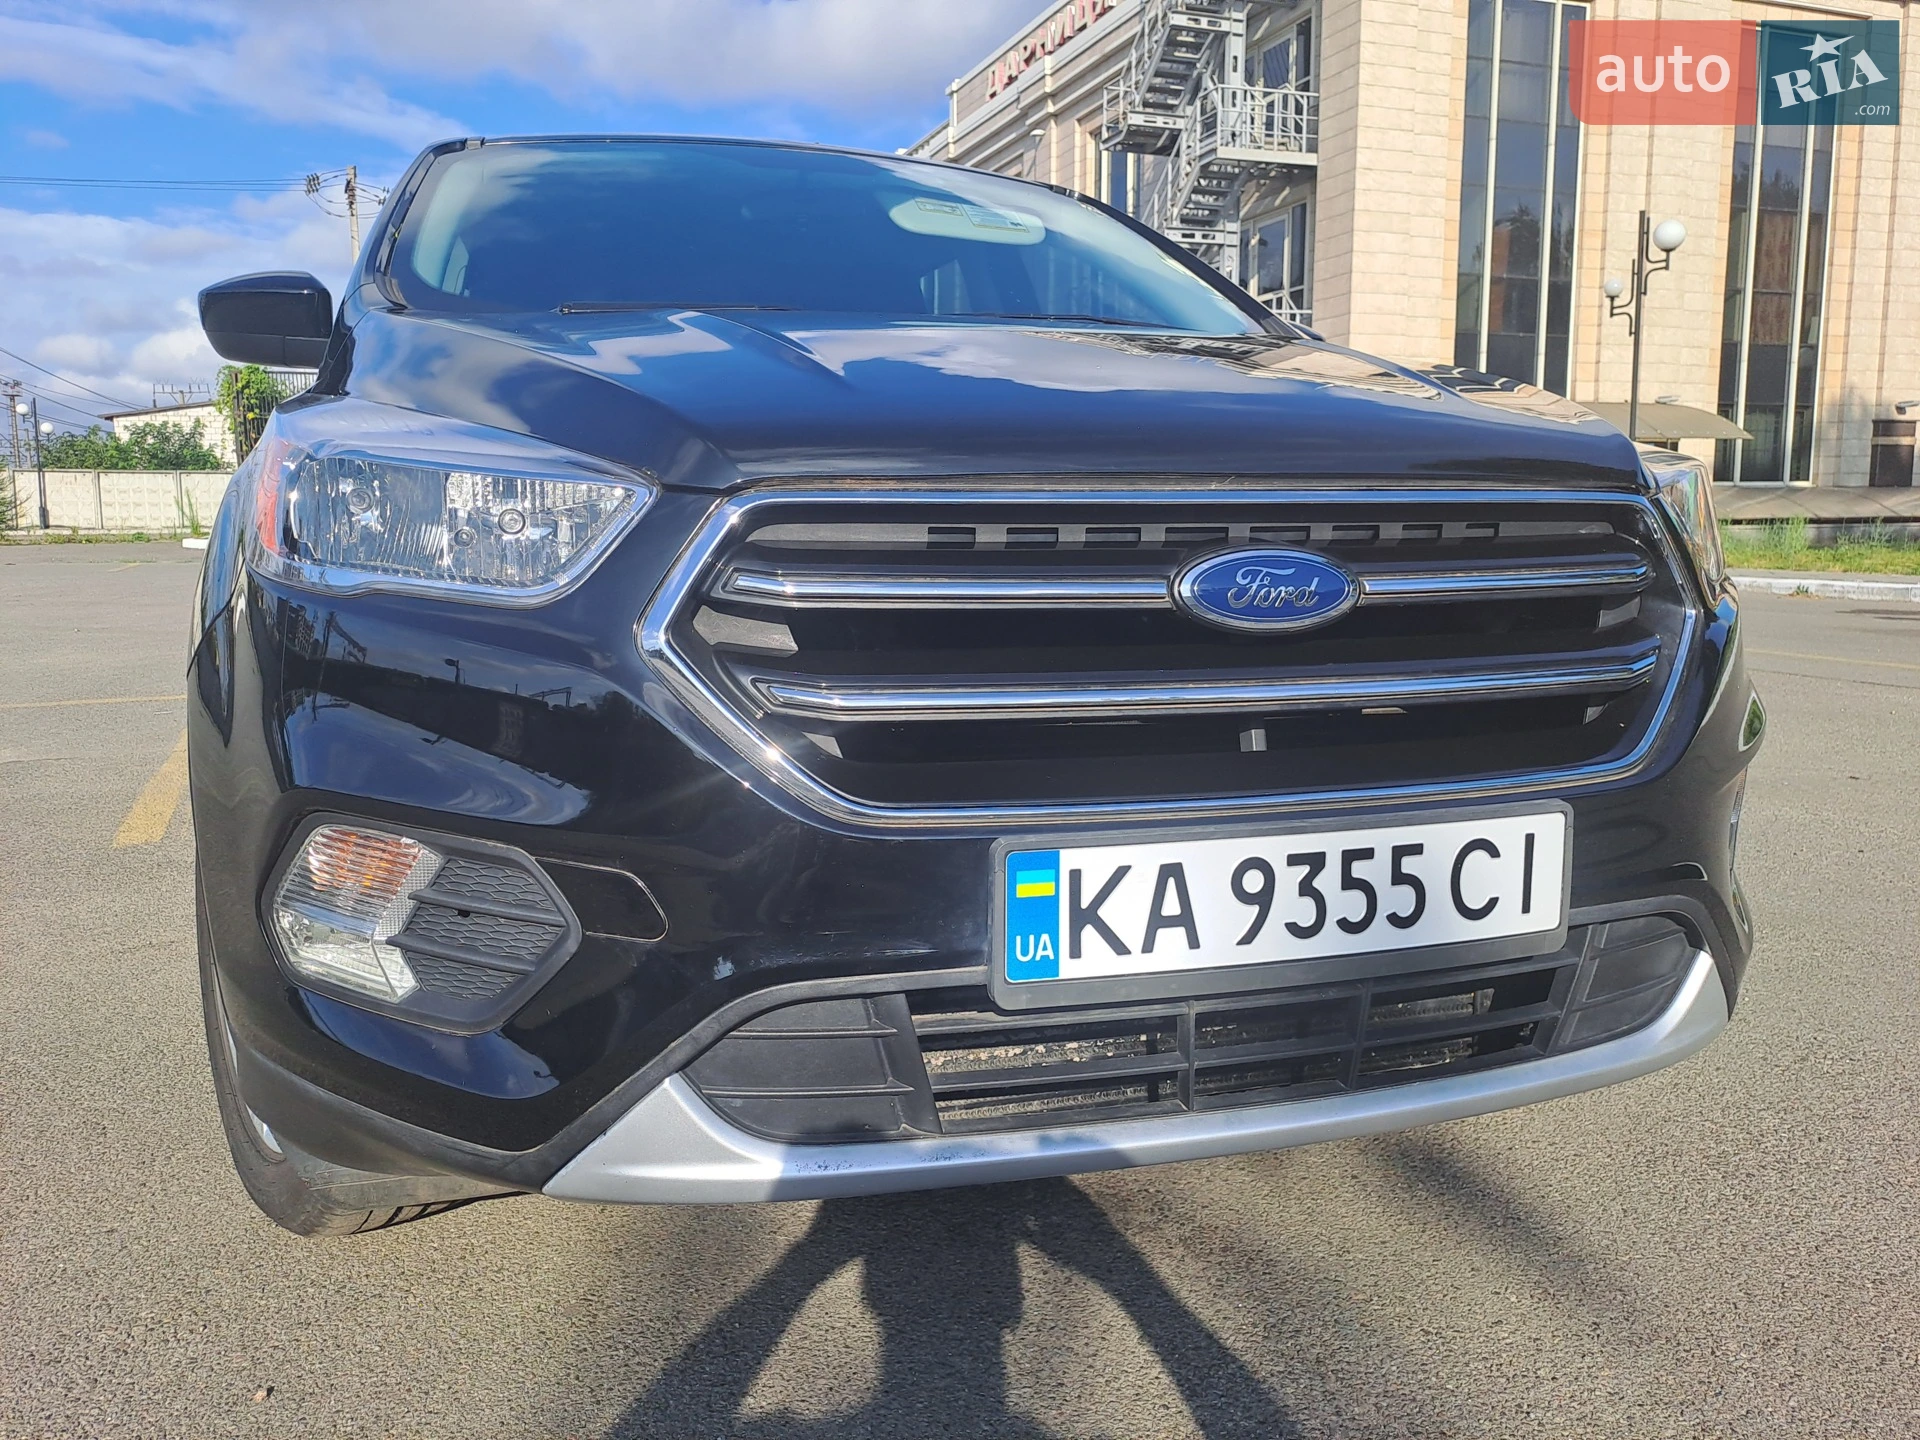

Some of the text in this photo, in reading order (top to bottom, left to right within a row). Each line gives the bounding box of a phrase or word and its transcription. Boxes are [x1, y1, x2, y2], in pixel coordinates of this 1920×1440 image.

[1227, 566, 1320, 608] Ford
[1068, 832, 1536, 960] KA 9355 CI
[1015, 932, 1055, 963] UA
